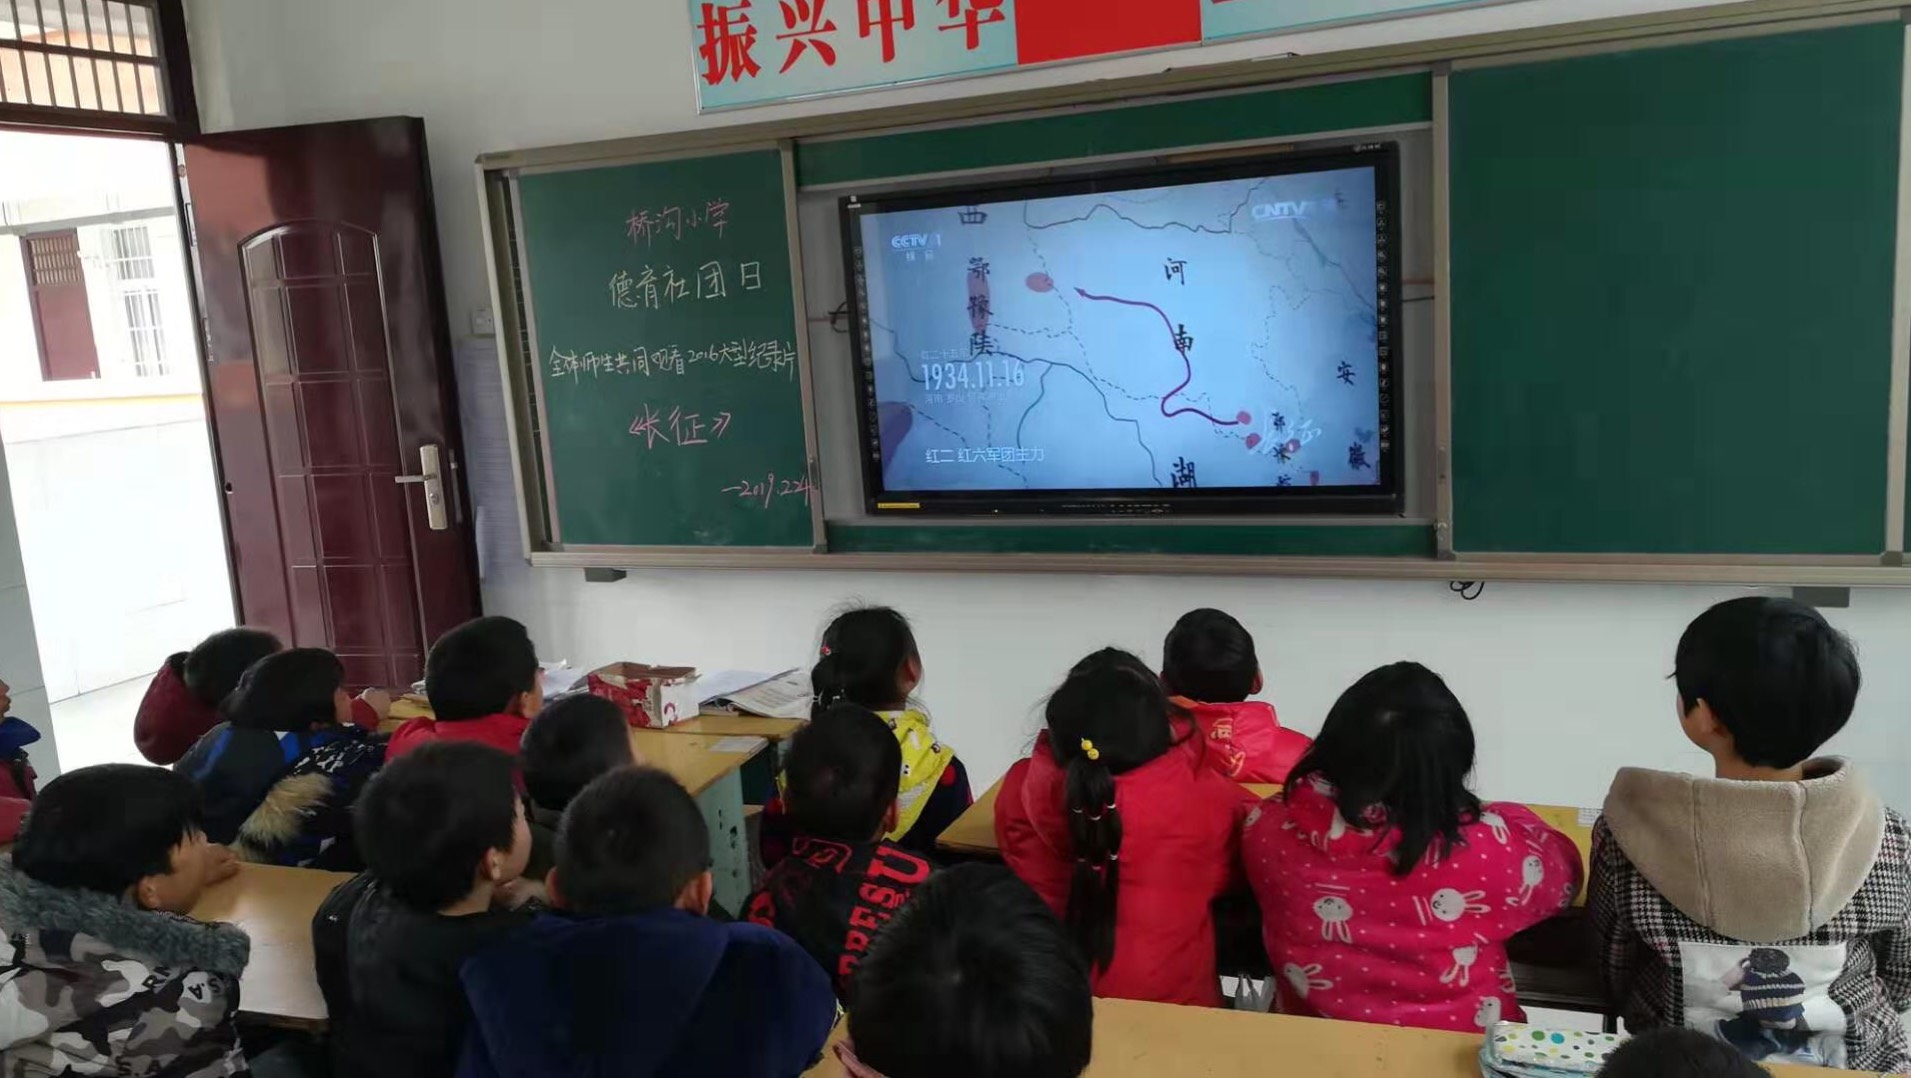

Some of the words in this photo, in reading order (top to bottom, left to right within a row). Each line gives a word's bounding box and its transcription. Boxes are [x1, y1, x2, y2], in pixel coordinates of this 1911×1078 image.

[625, 197, 730, 246] 桥沟小学
[1251, 201, 1308, 219] CNTV
[891, 233, 927, 249] CCTV
[608, 260, 761, 309] 德育社团日
[922, 358, 1025, 391] 1934.11.16
[628, 402, 732, 449] 《长征》
